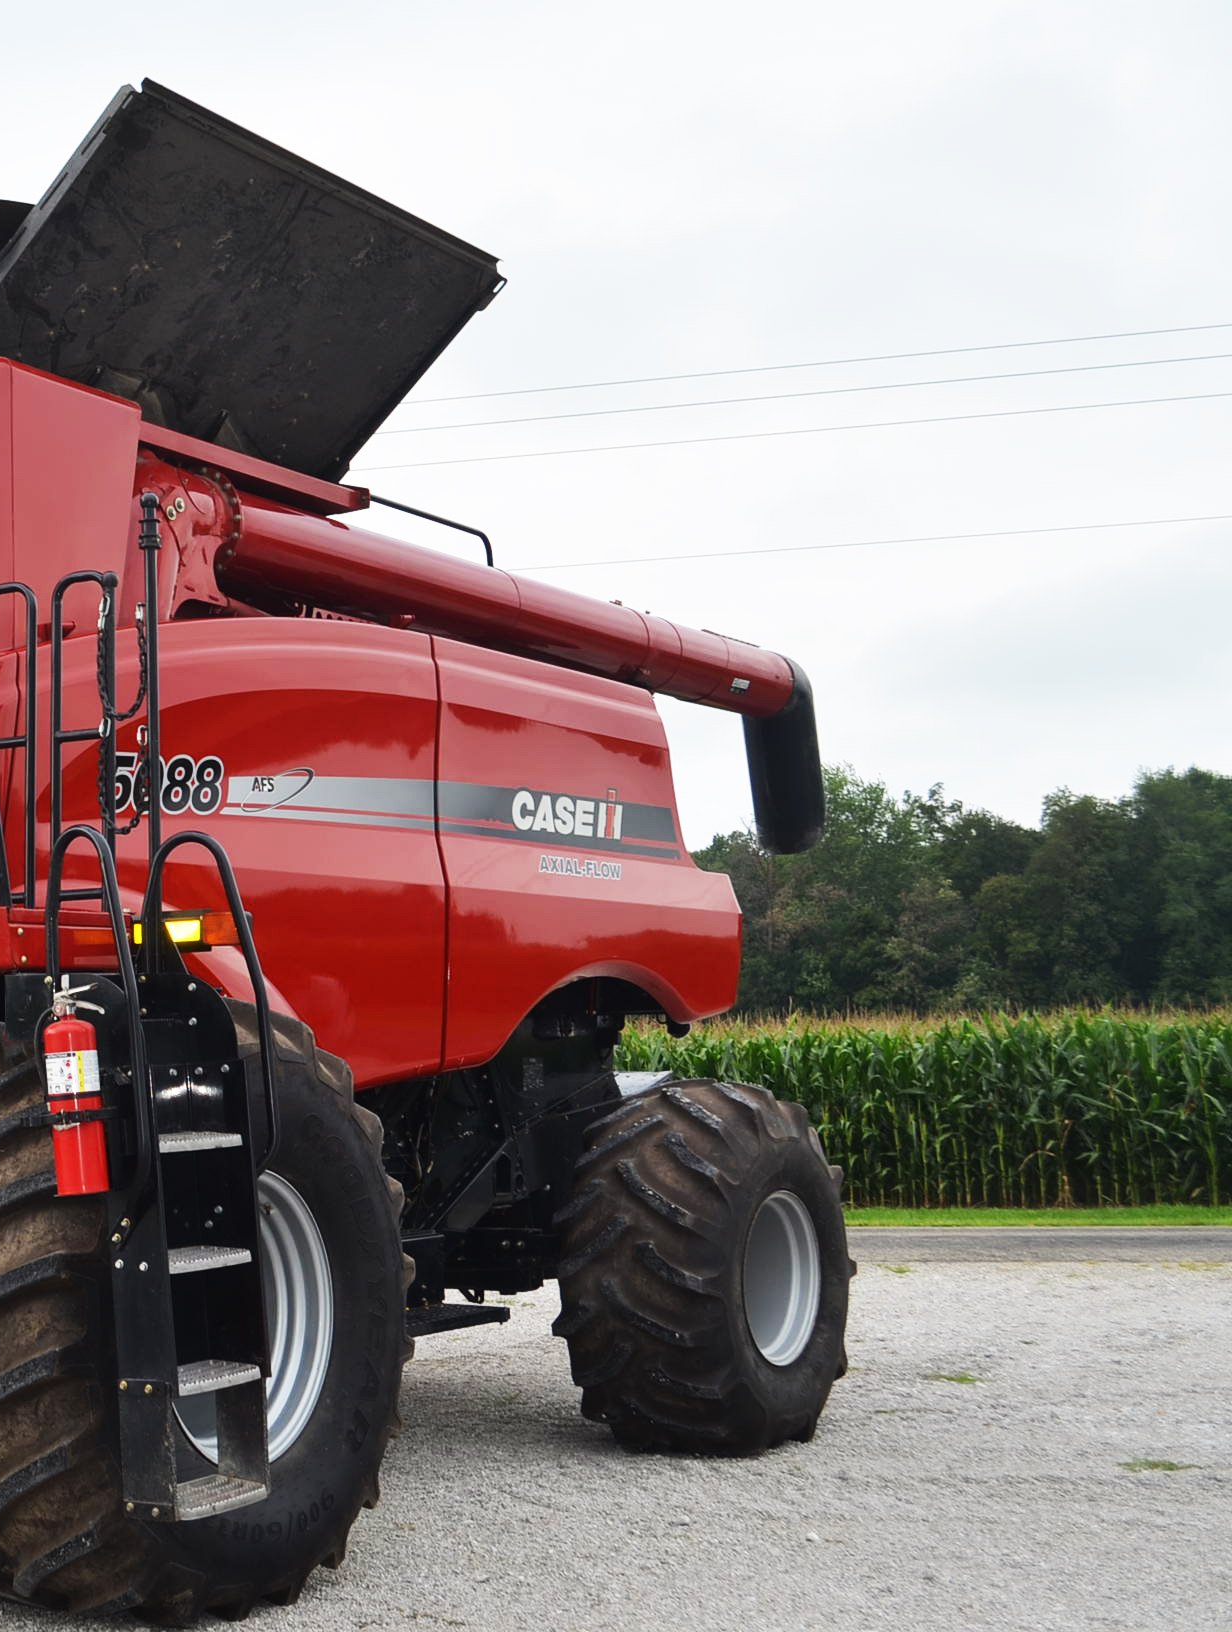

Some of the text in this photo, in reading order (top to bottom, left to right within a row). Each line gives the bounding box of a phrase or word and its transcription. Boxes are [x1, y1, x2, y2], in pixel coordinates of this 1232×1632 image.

[251, 777, 275, 793] AFS
[511, 790, 596, 837] CASE
[539, 855, 621, 880] AXIAL-FLOW
